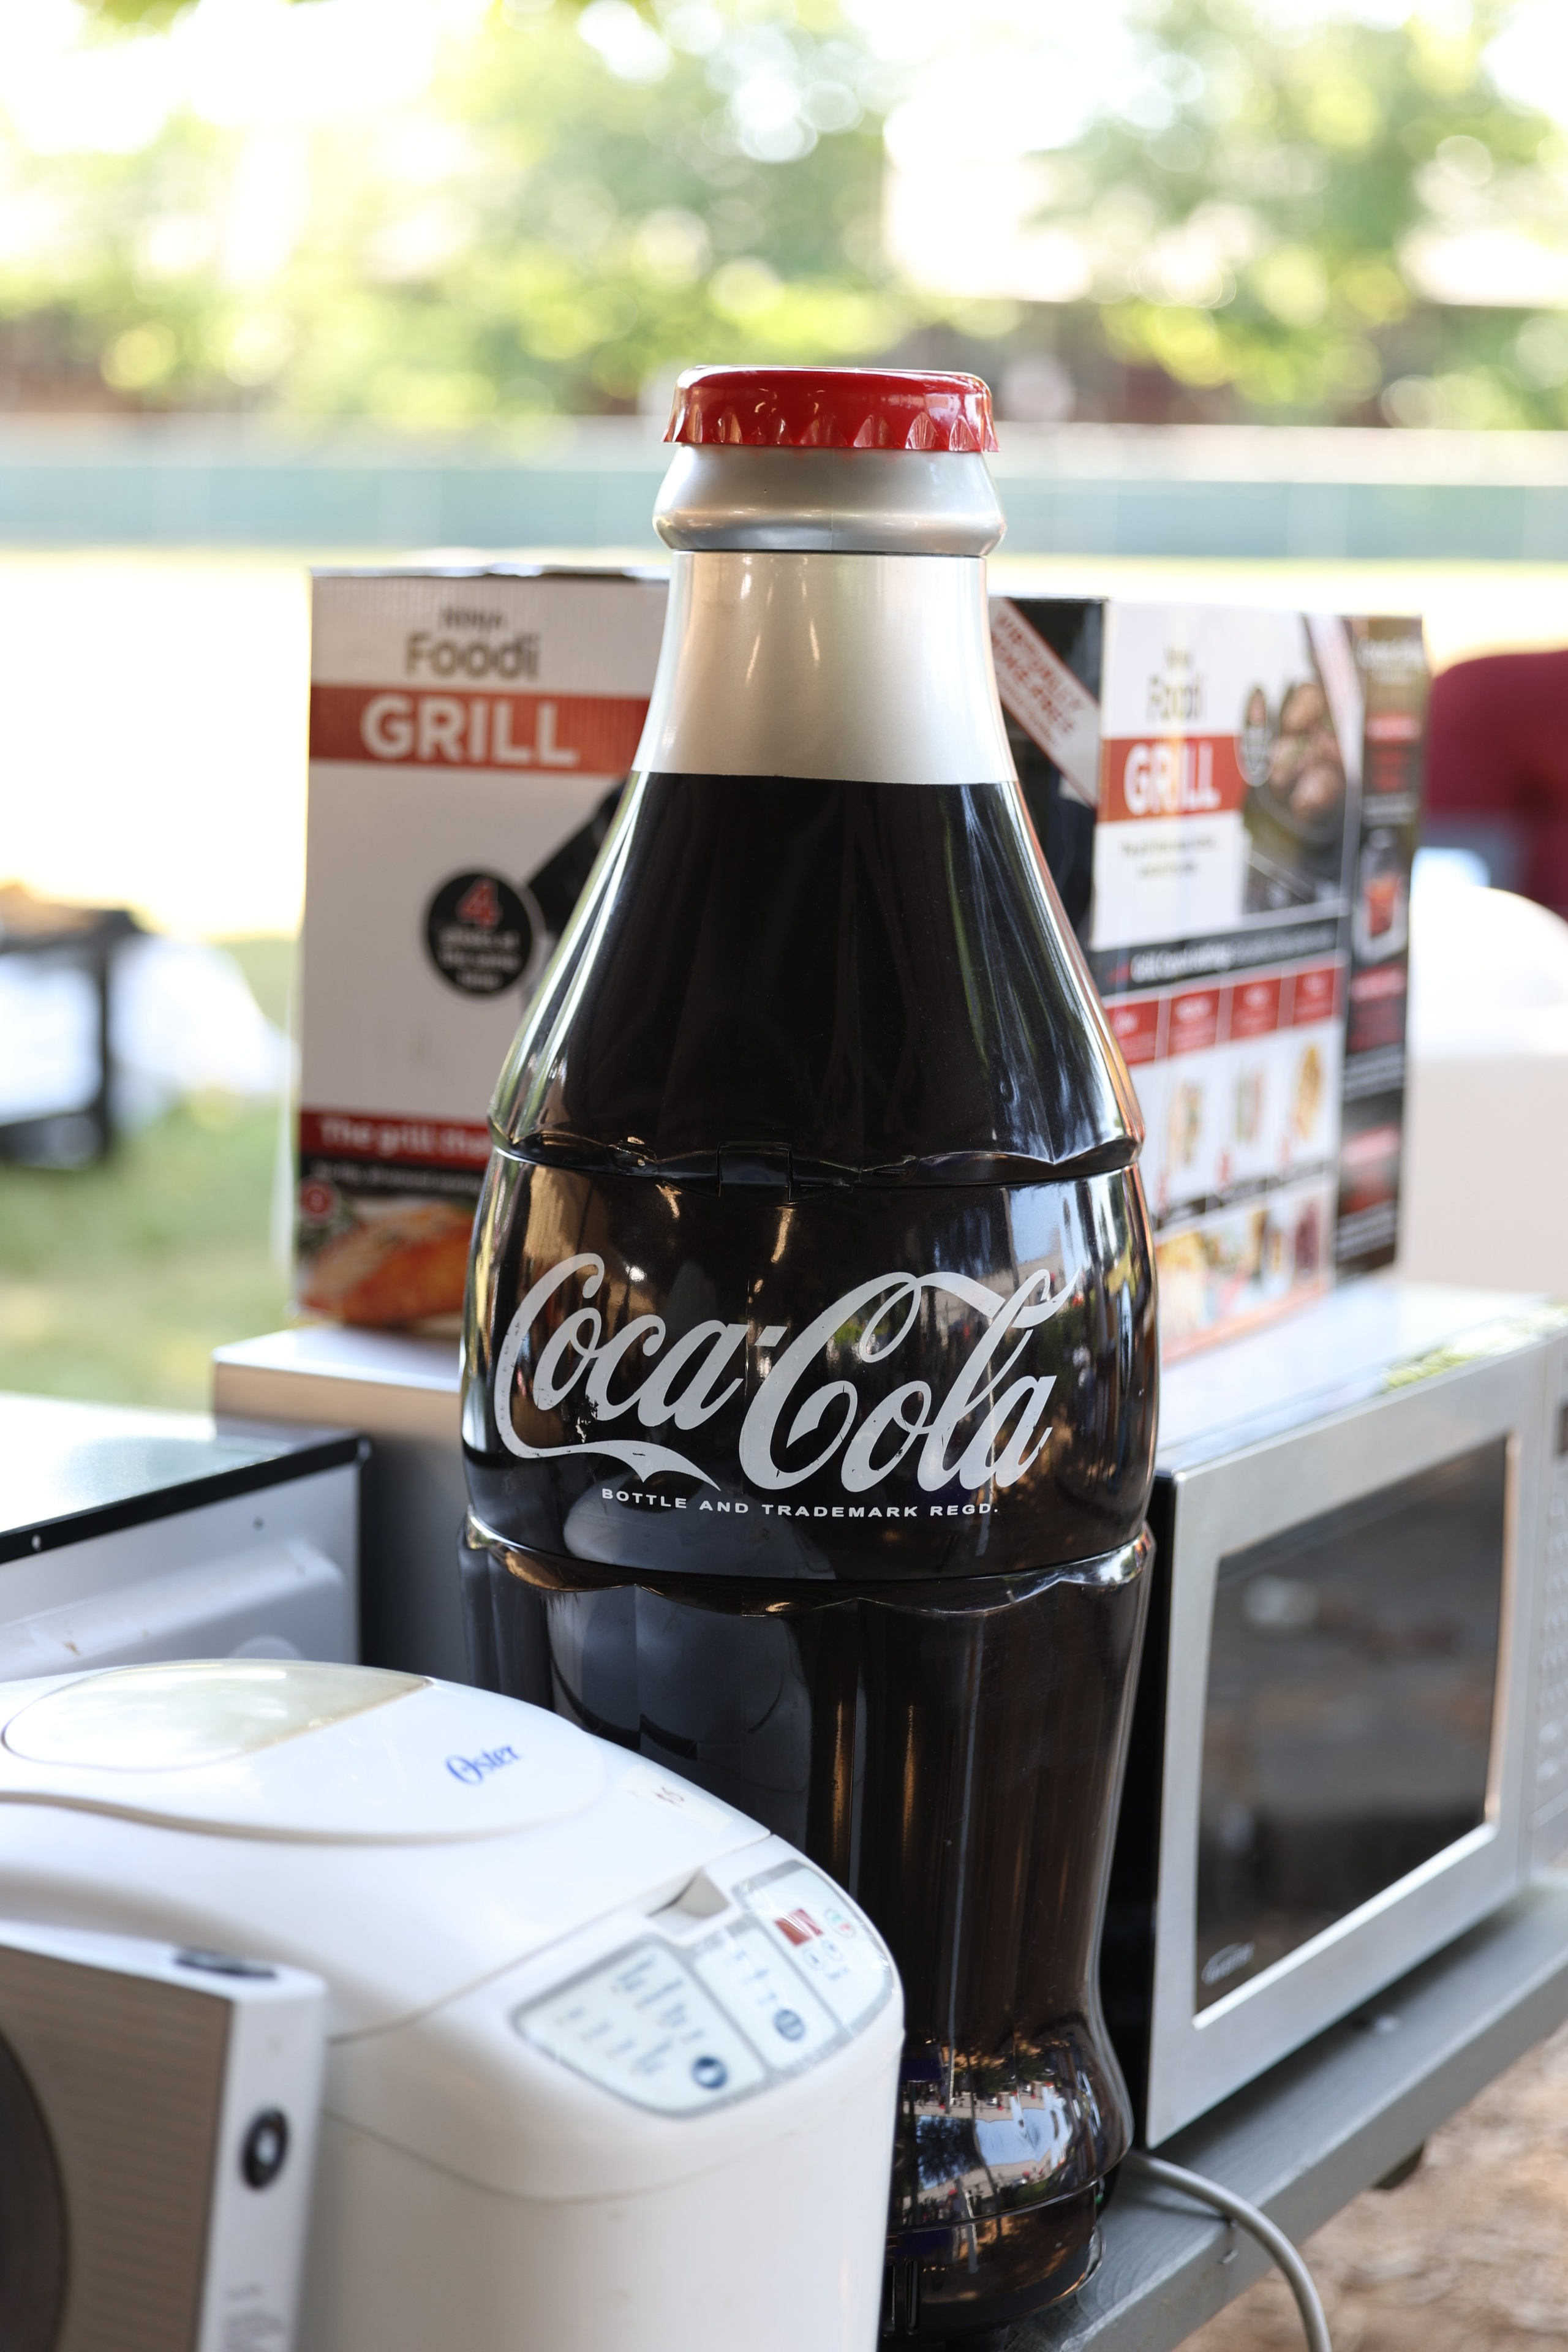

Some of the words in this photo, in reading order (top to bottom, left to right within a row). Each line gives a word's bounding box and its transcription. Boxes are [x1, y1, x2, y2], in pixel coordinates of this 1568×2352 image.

[405, 631, 540, 679] Foodi
[360, 692, 579, 767] GRILL
[1123, 741, 1221, 816] GRILL
[494, 1253, 1079, 1492] Coca-Cola
[601, 1488, 687, 1509] BOTTLE
[699, 1500, 748, 1513] AND
[762, 1504, 918, 1518] TRADEMARK
[445, 1744, 522, 1786] Oster
